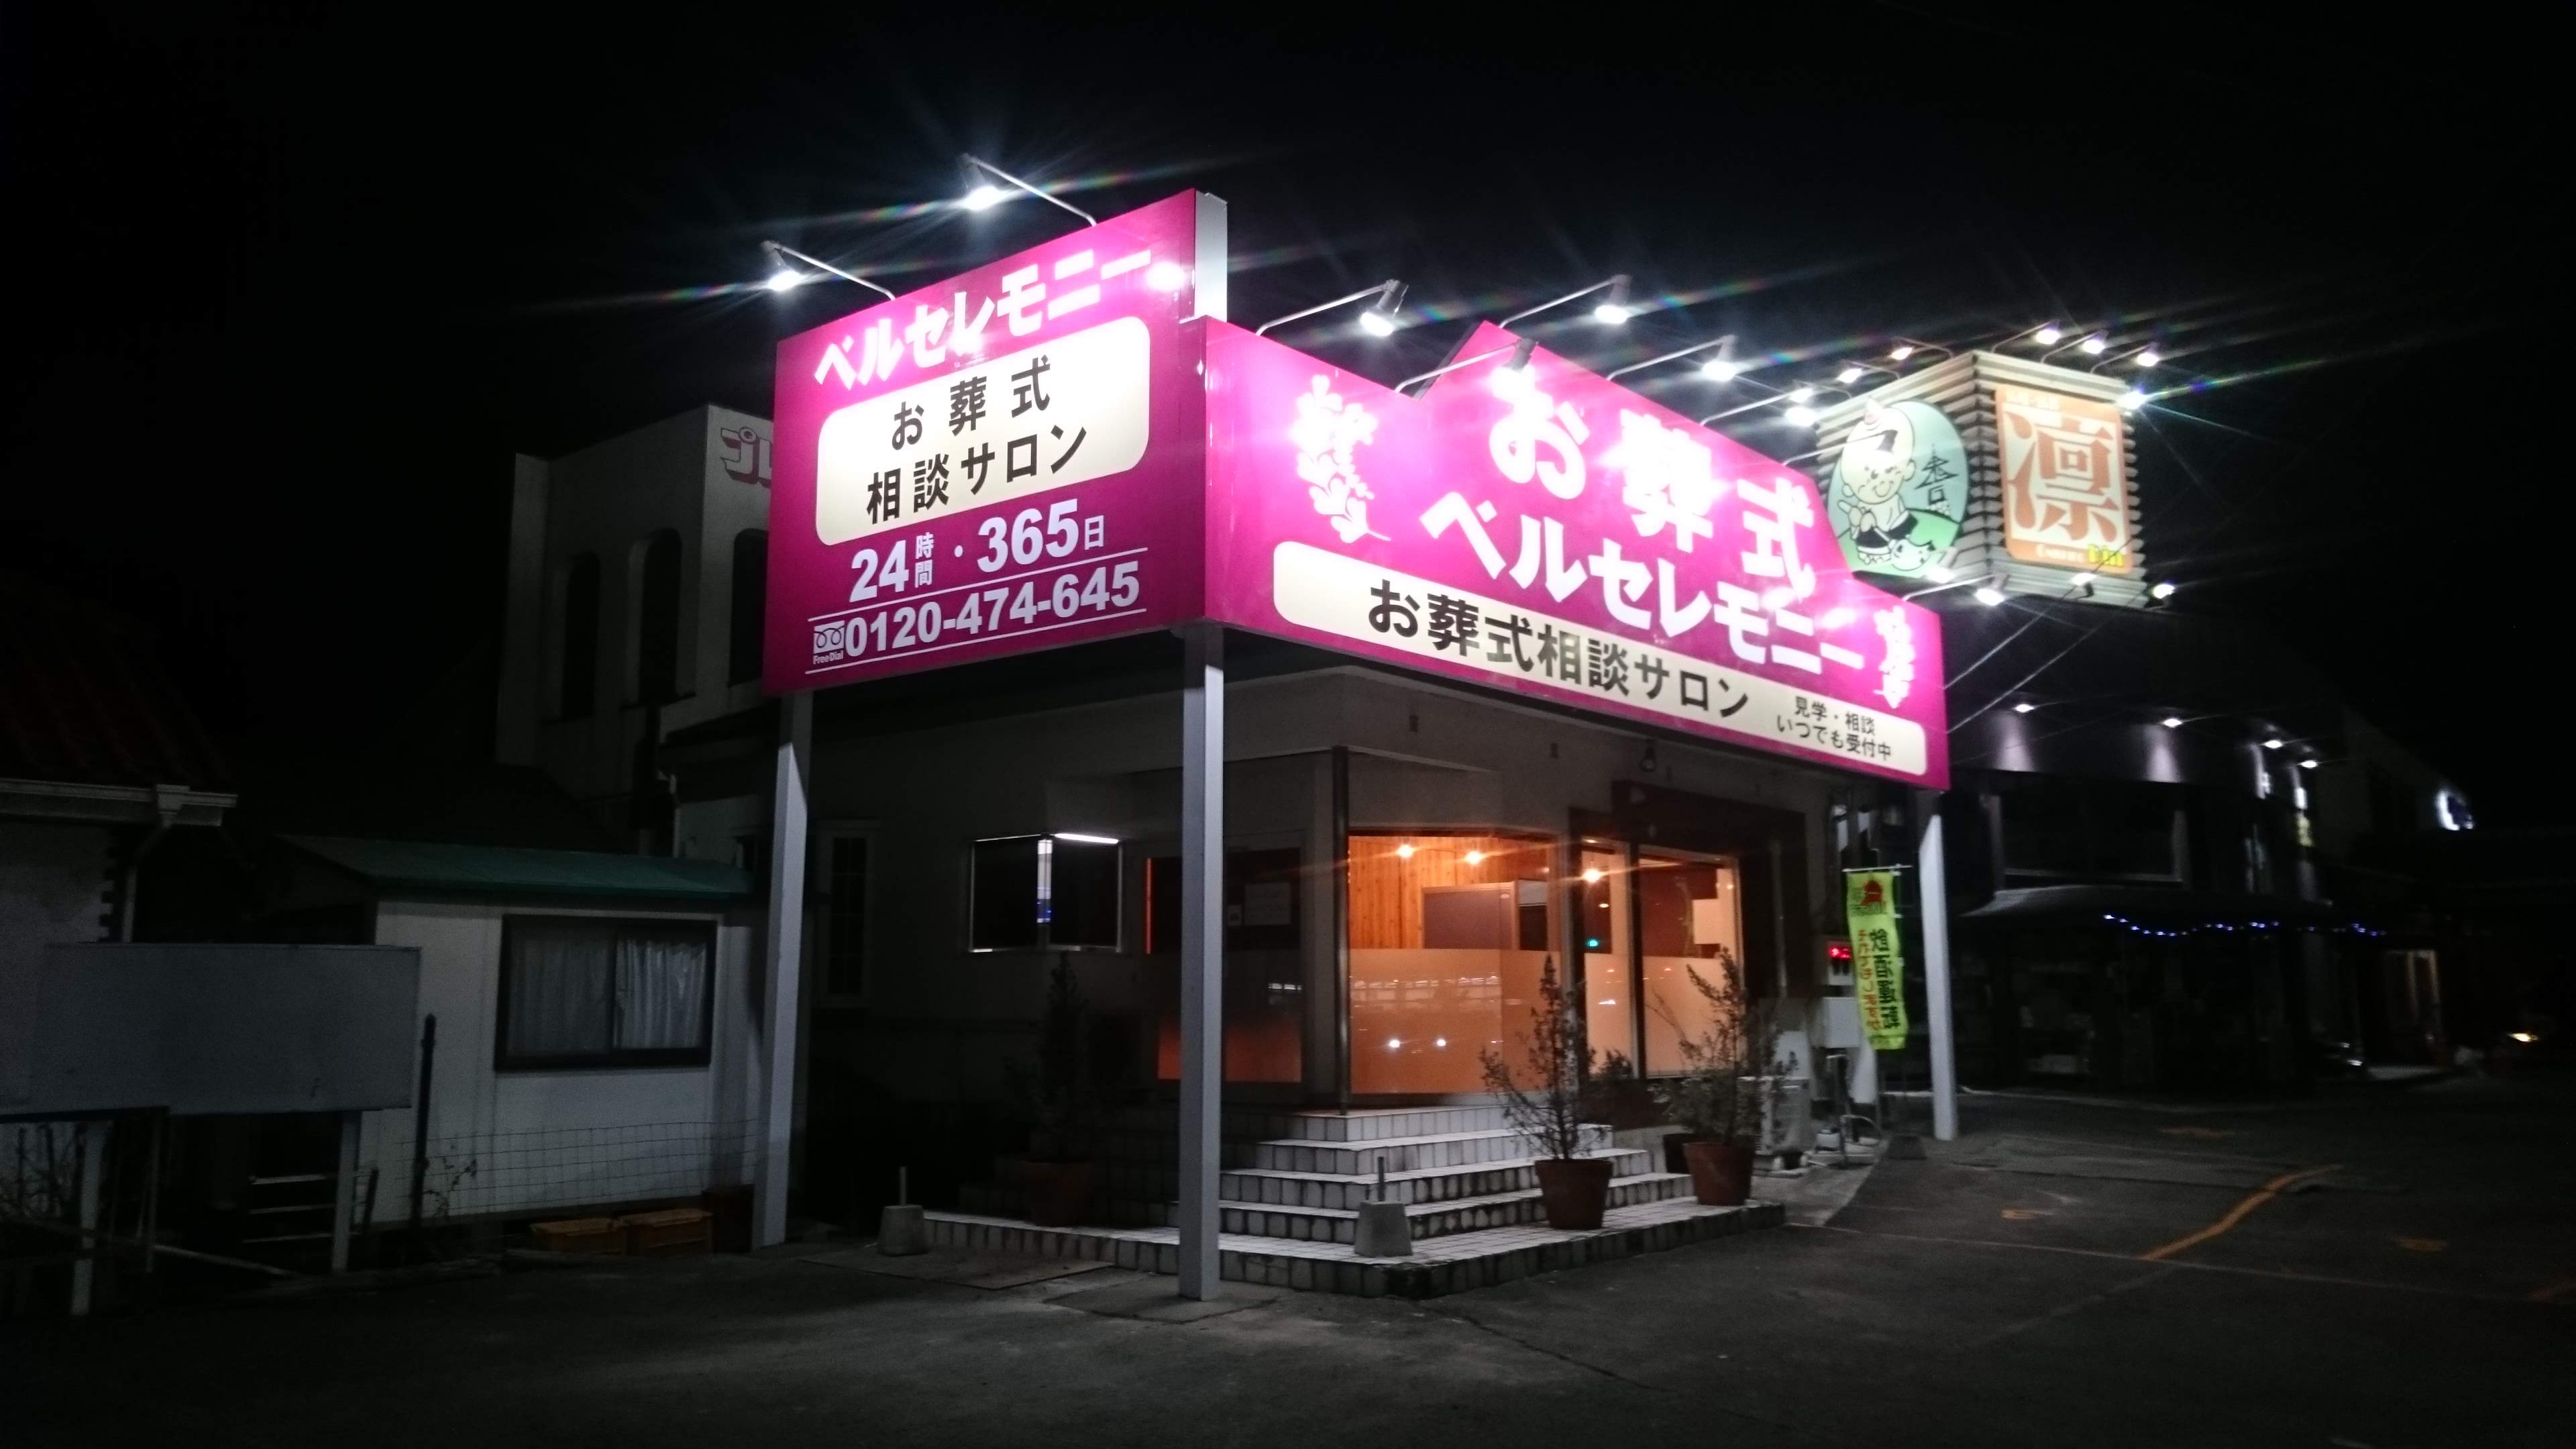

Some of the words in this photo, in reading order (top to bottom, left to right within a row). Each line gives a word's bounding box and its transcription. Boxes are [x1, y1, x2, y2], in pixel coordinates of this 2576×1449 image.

[814, 249, 1152, 390] ベルセレモニー
[892, 355, 1051, 451] お葬式
[867, 425, 1087, 525] 相談サロン
[1489, 365, 1816, 600] お葬式
[845, 561, 1140, 657] 0120-474-645
[1419, 492, 1864, 674] ベルセレモニー
[1368, 579, 1750, 719] お葬式相談サロン
[1777, 714, 1892, 761] いつでも受付中
[1794, 695, 1876, 736] 見学・相談
